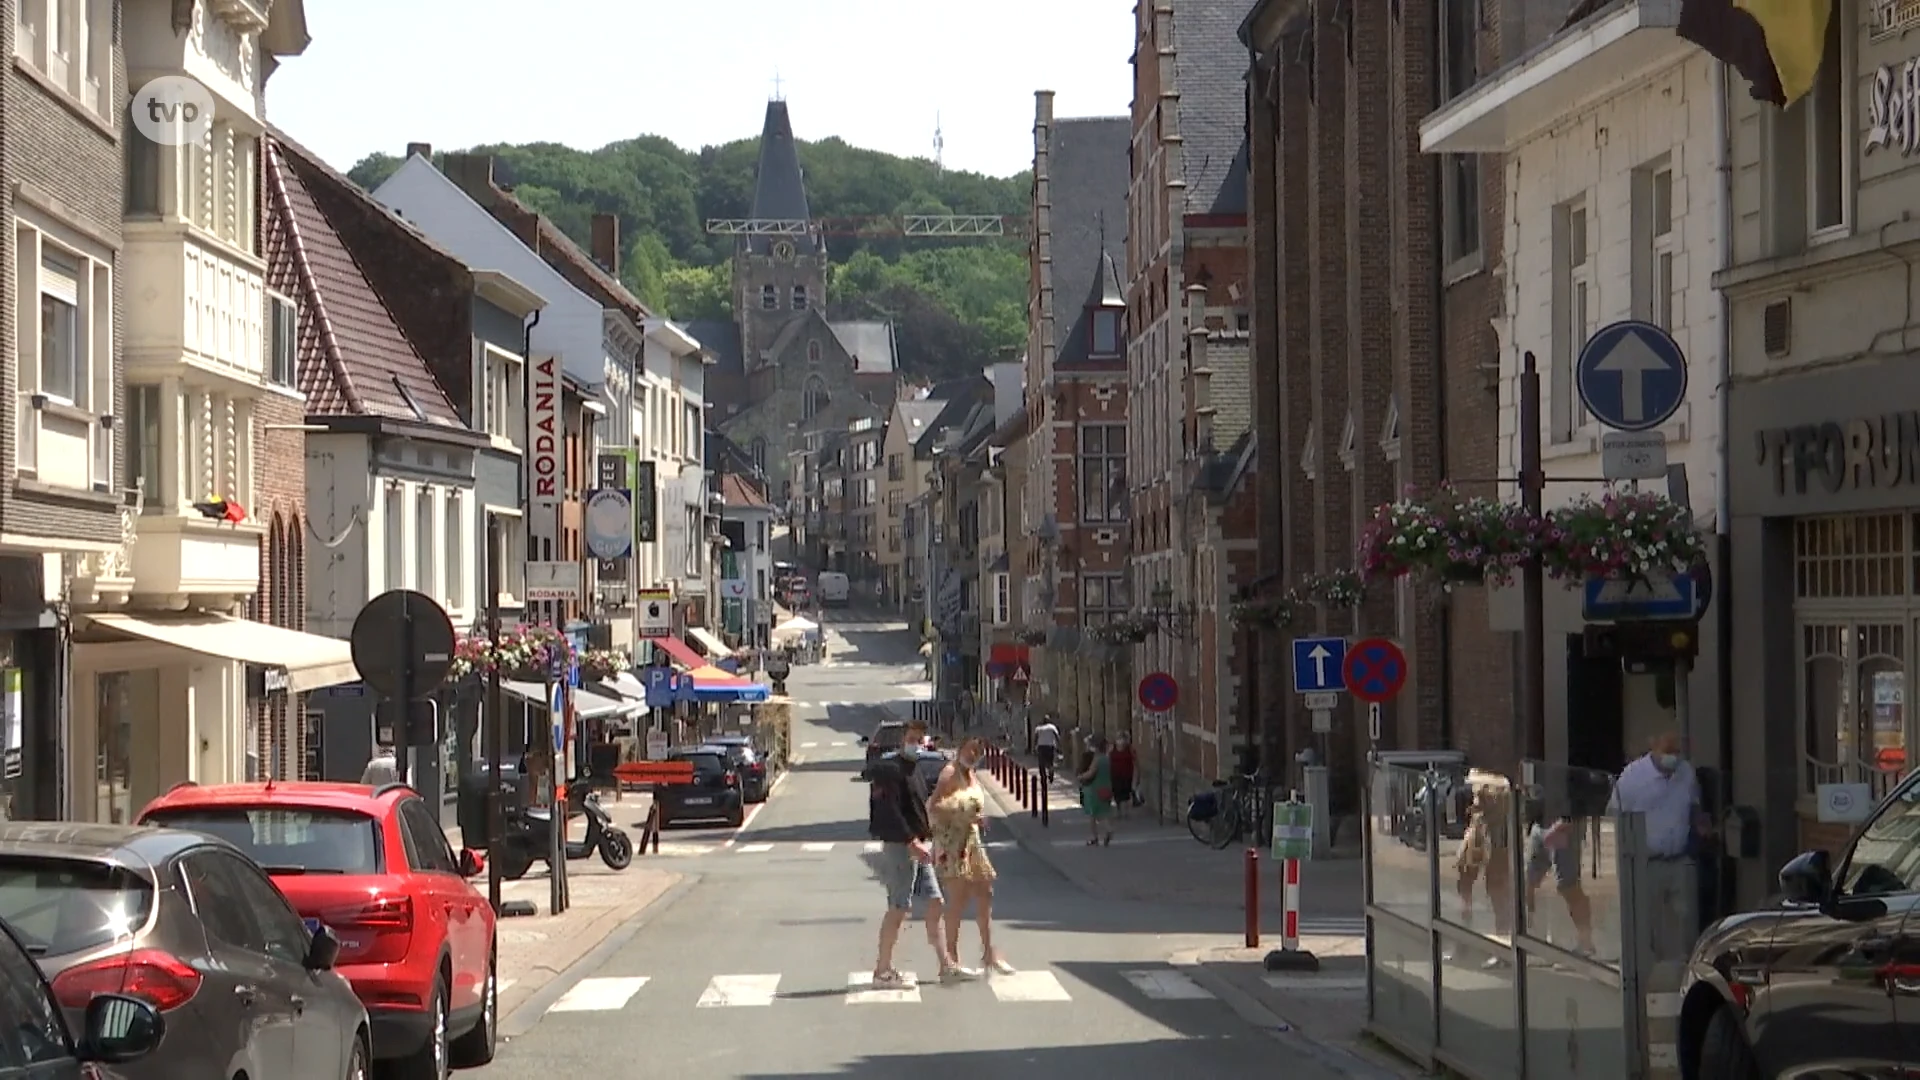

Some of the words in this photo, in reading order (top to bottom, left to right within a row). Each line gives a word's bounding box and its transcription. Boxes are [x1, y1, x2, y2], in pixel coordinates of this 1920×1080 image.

[535, 357, 555, 496] RODANIA
[529, 589, 576, 598] RODANIA
[652, 671, 663, 687] P
